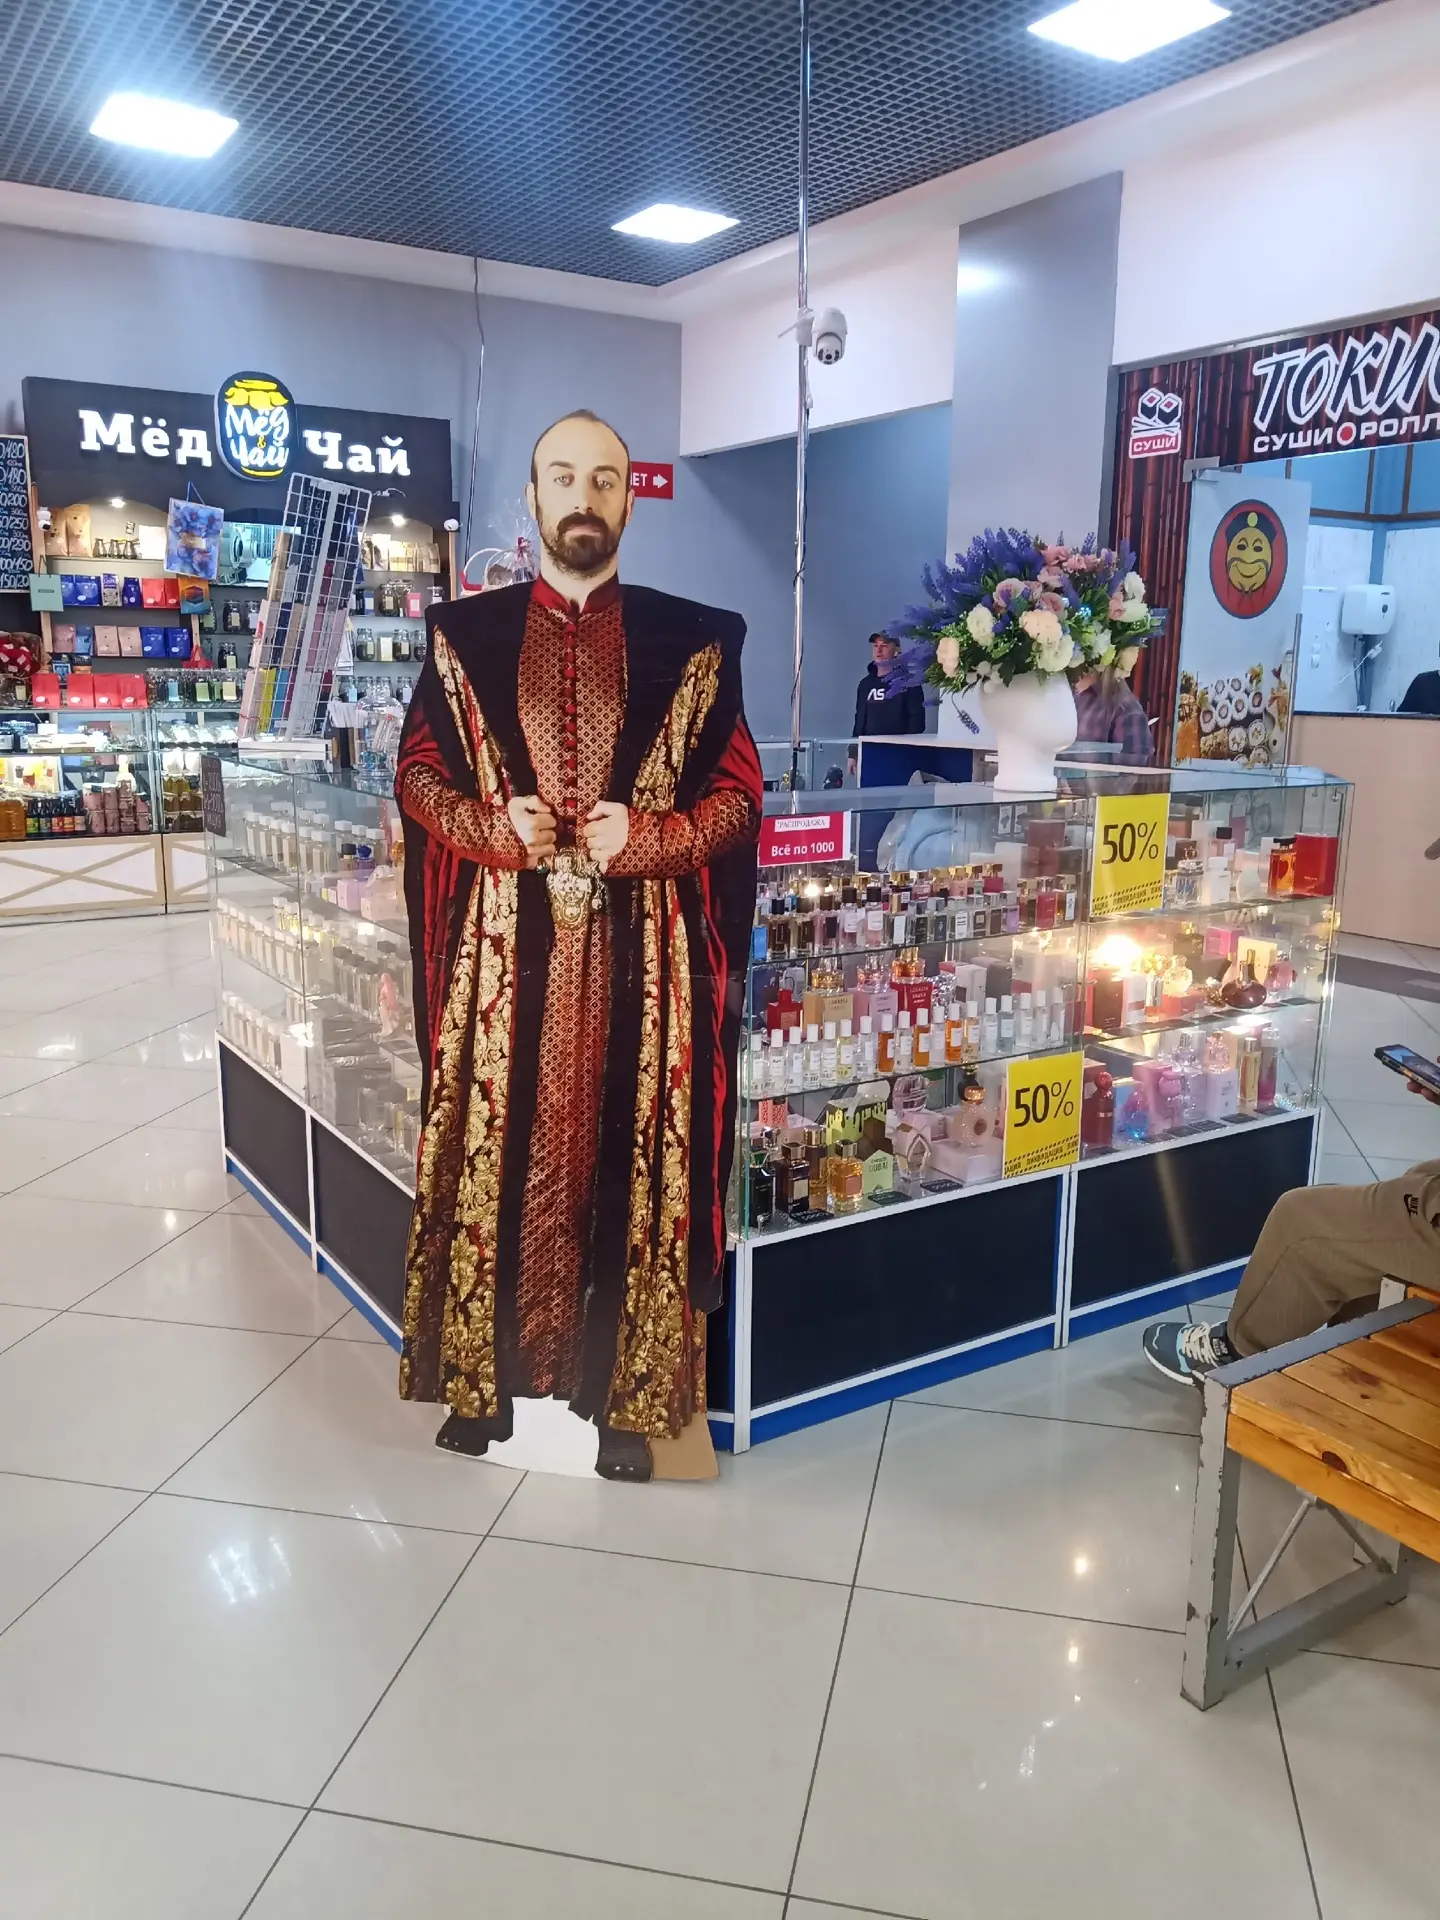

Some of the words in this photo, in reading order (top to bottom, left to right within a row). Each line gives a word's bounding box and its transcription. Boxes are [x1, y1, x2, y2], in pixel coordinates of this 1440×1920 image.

[1252, 321, 1440, 433] ТОКИ
[79, 409, 213, 467] Мёд
[225, 403, 290, 441] Мёд
[1253, 428, 1334, 453] СУШИ
[302, 429, 411, 477] Чай
[1132, 436, 1177, 453] СУШИ
[630, 472, 648, 487] ЕТ
[771, 844, 791, 857] Всё
[794, 845, 808, 855] по
[810, 841, 835, 854] 1000
[1101, 821, 1159, 865] 50%
[1013, 1079, 1074, 1128] 50%
[1026, 1146, 1064, 1166] ЛИКВИДАЦИЯ
